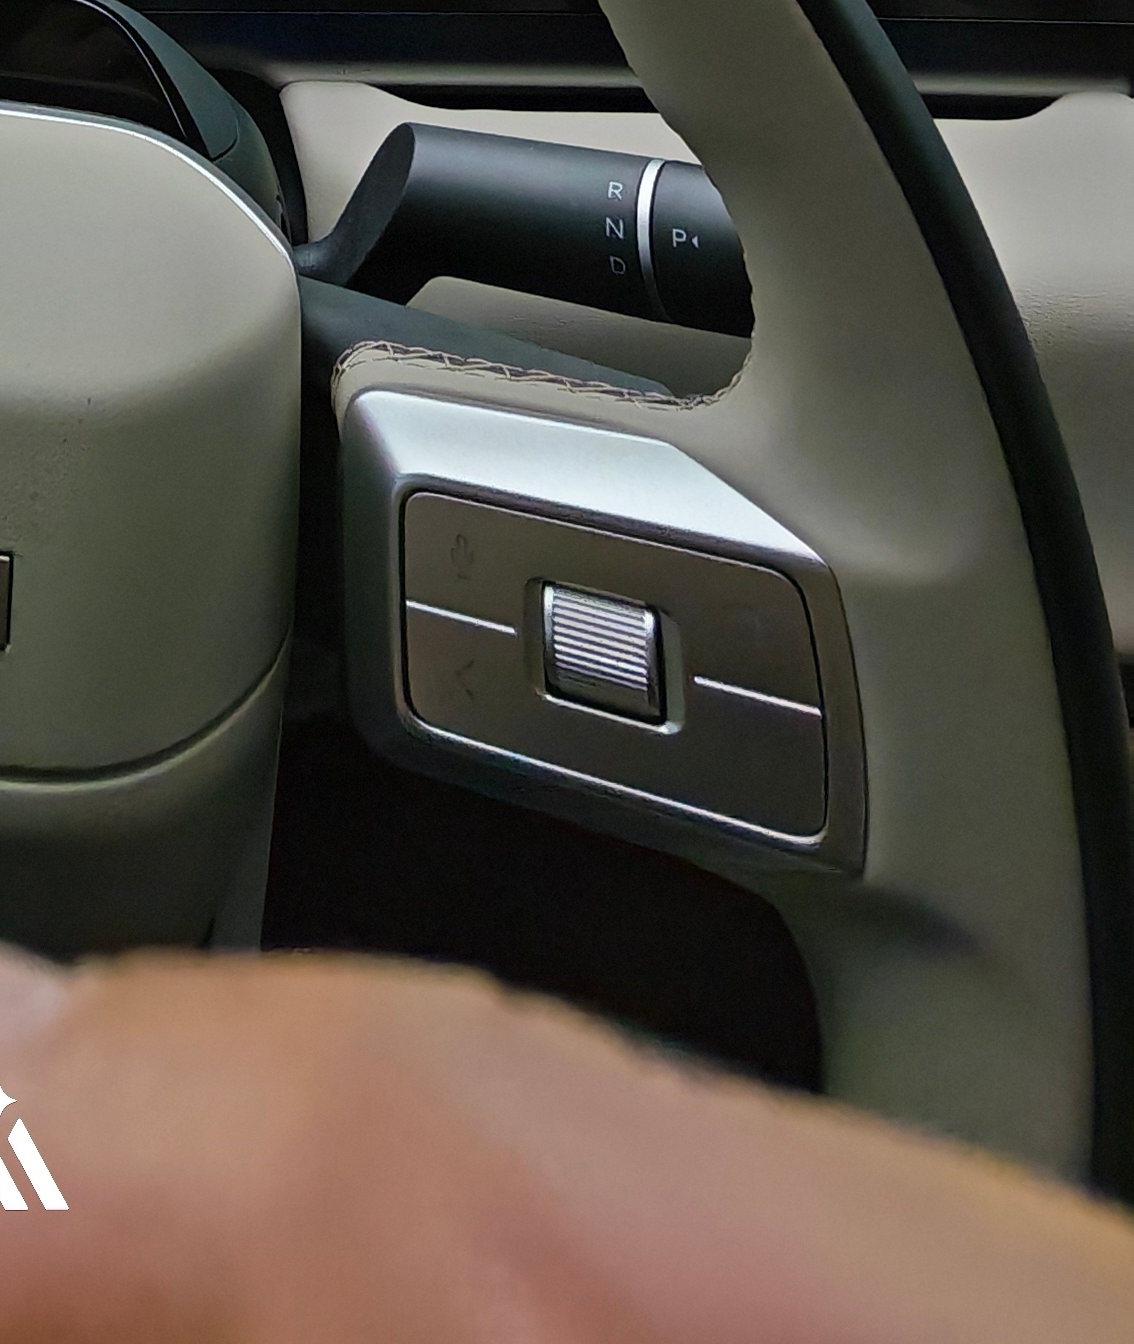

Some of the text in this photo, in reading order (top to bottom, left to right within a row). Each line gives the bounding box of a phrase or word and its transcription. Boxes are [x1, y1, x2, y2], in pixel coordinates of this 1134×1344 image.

[607, 181, 623, 200] R
[605, 216, 624, 240] N
[671, 228, 687, 247] P
[609, 255, 626, 275] D
